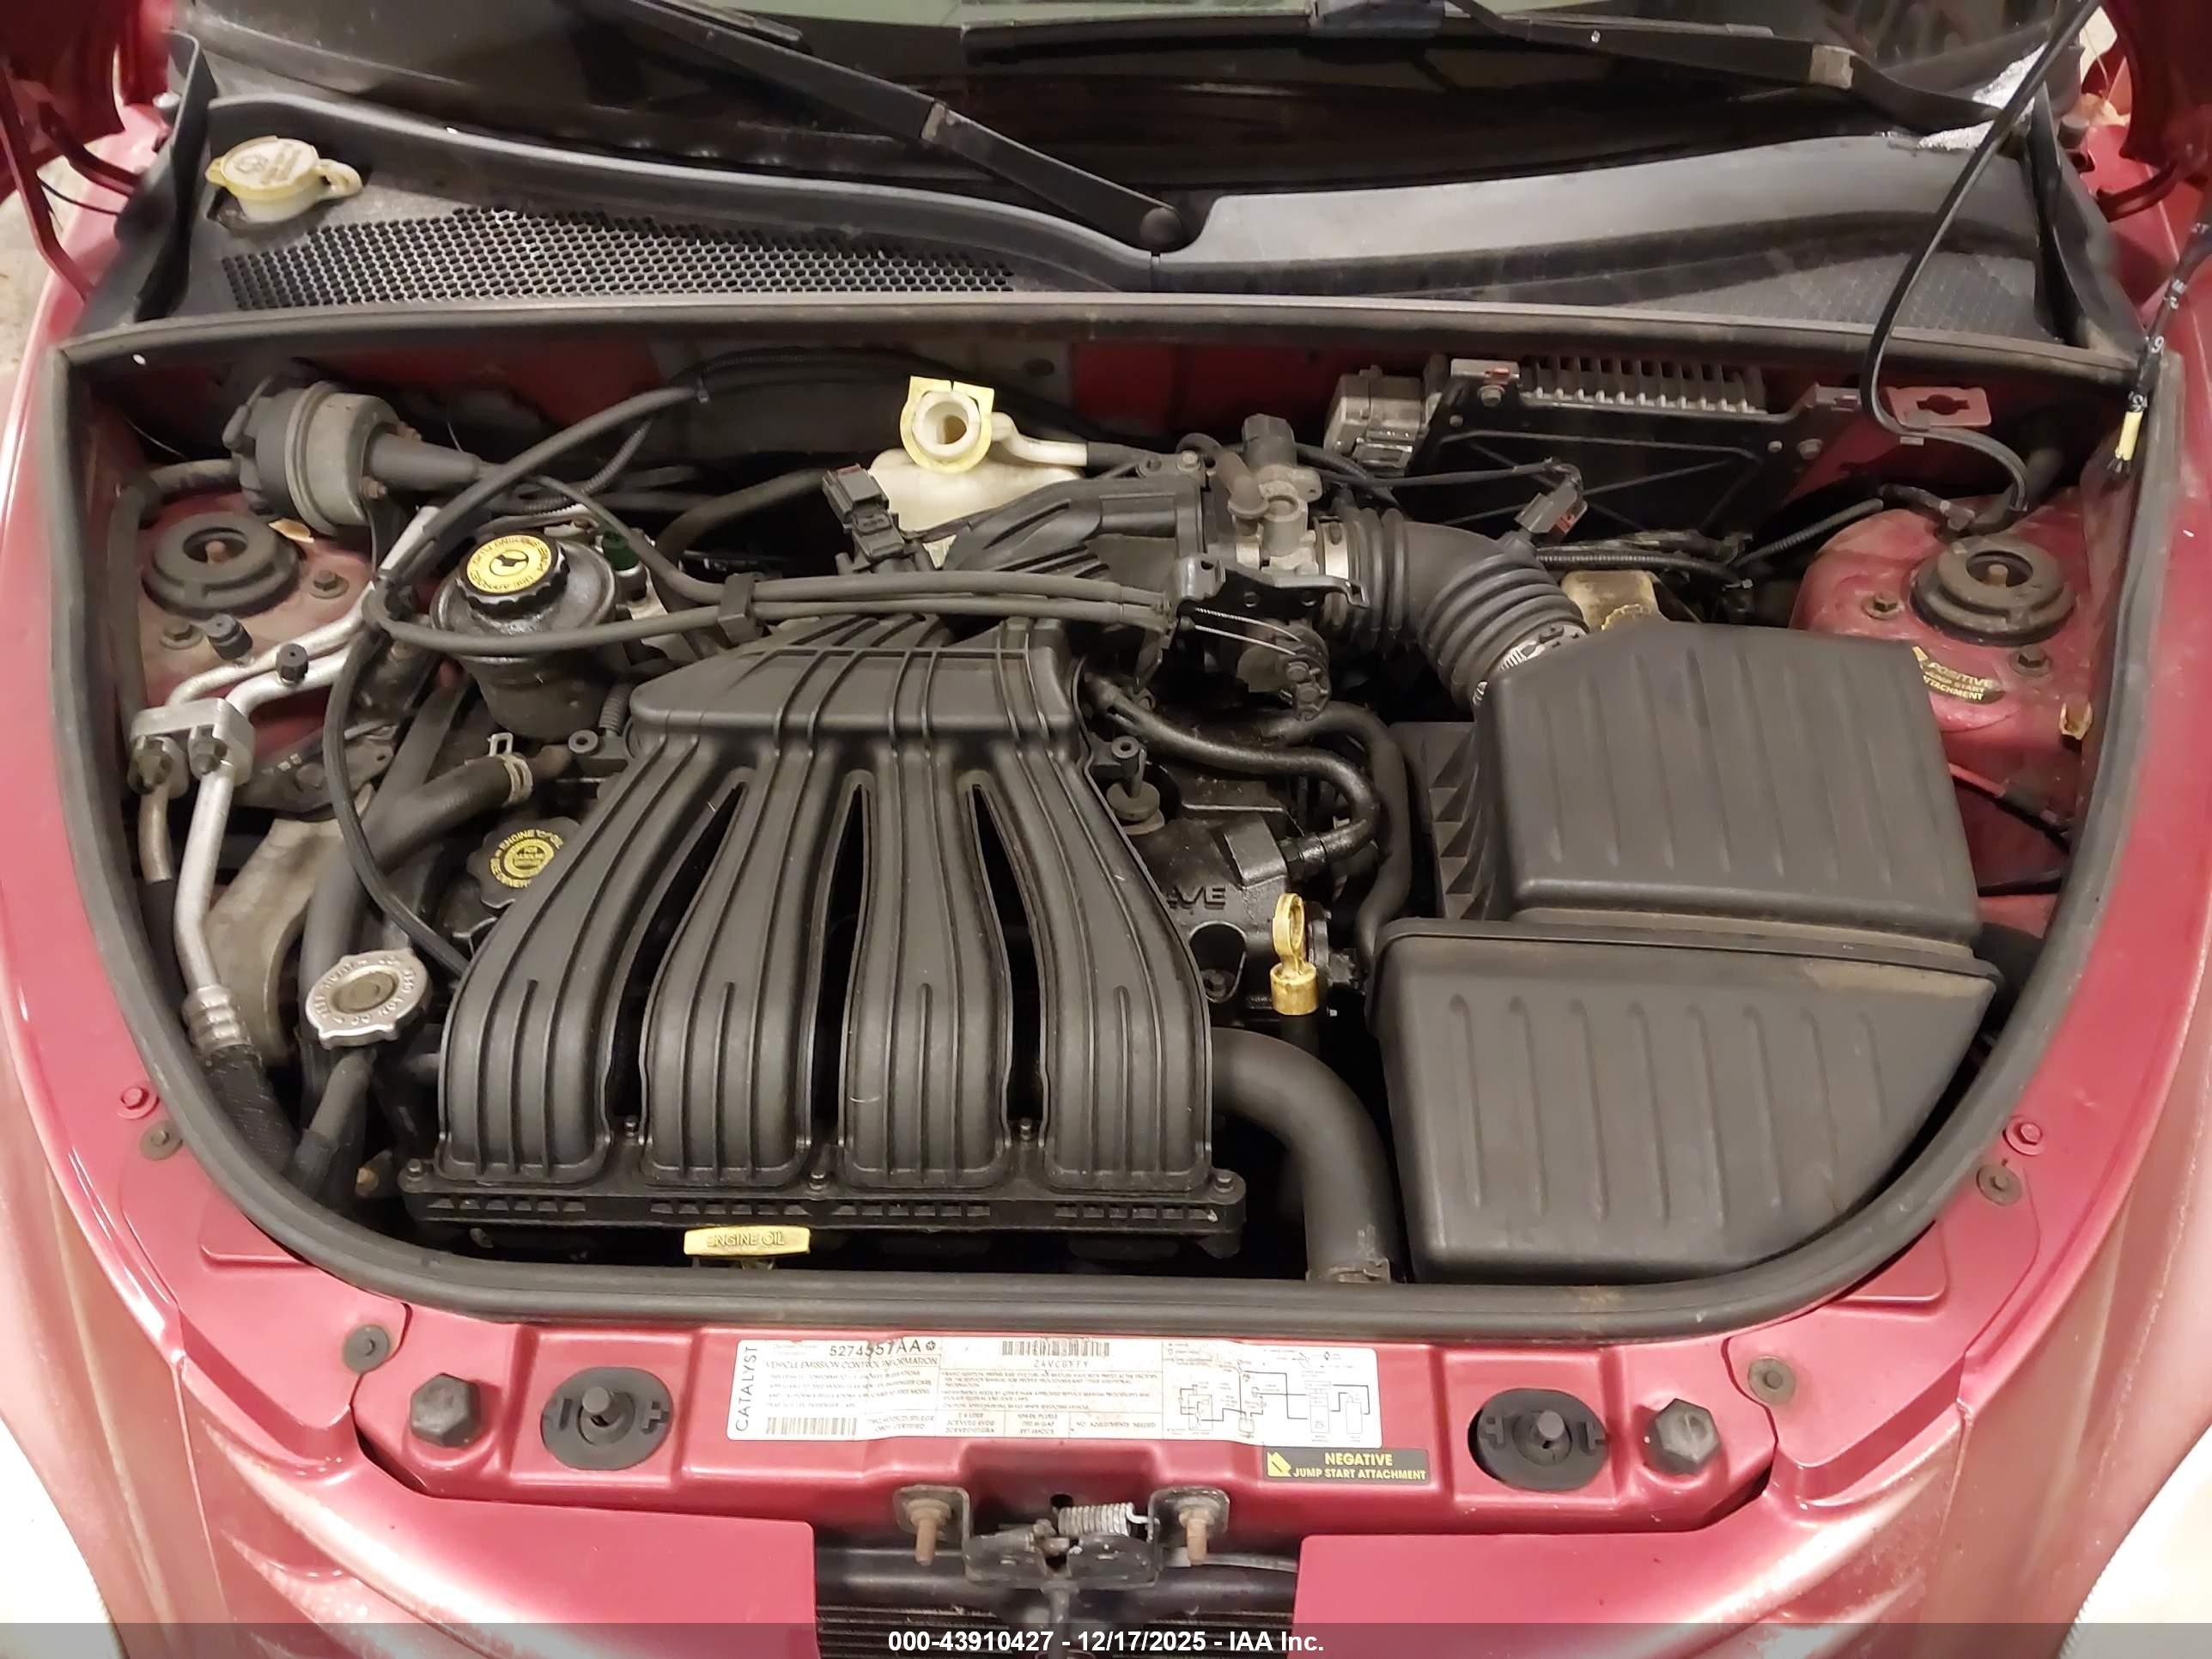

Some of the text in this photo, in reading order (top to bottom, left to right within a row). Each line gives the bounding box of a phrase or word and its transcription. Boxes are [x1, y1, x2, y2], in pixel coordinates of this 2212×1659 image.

[1928, 662, 1993, 687] POSITIVE
[707, 1231, 785, 1248] ENGINE OIL
[735, 1346, 757, 1432] CATALYST
[1324, 1452, 1393, 1466] NEGATIVE
[1293, 1468, 1426, 1480] JUMP START ATTACHMENT
